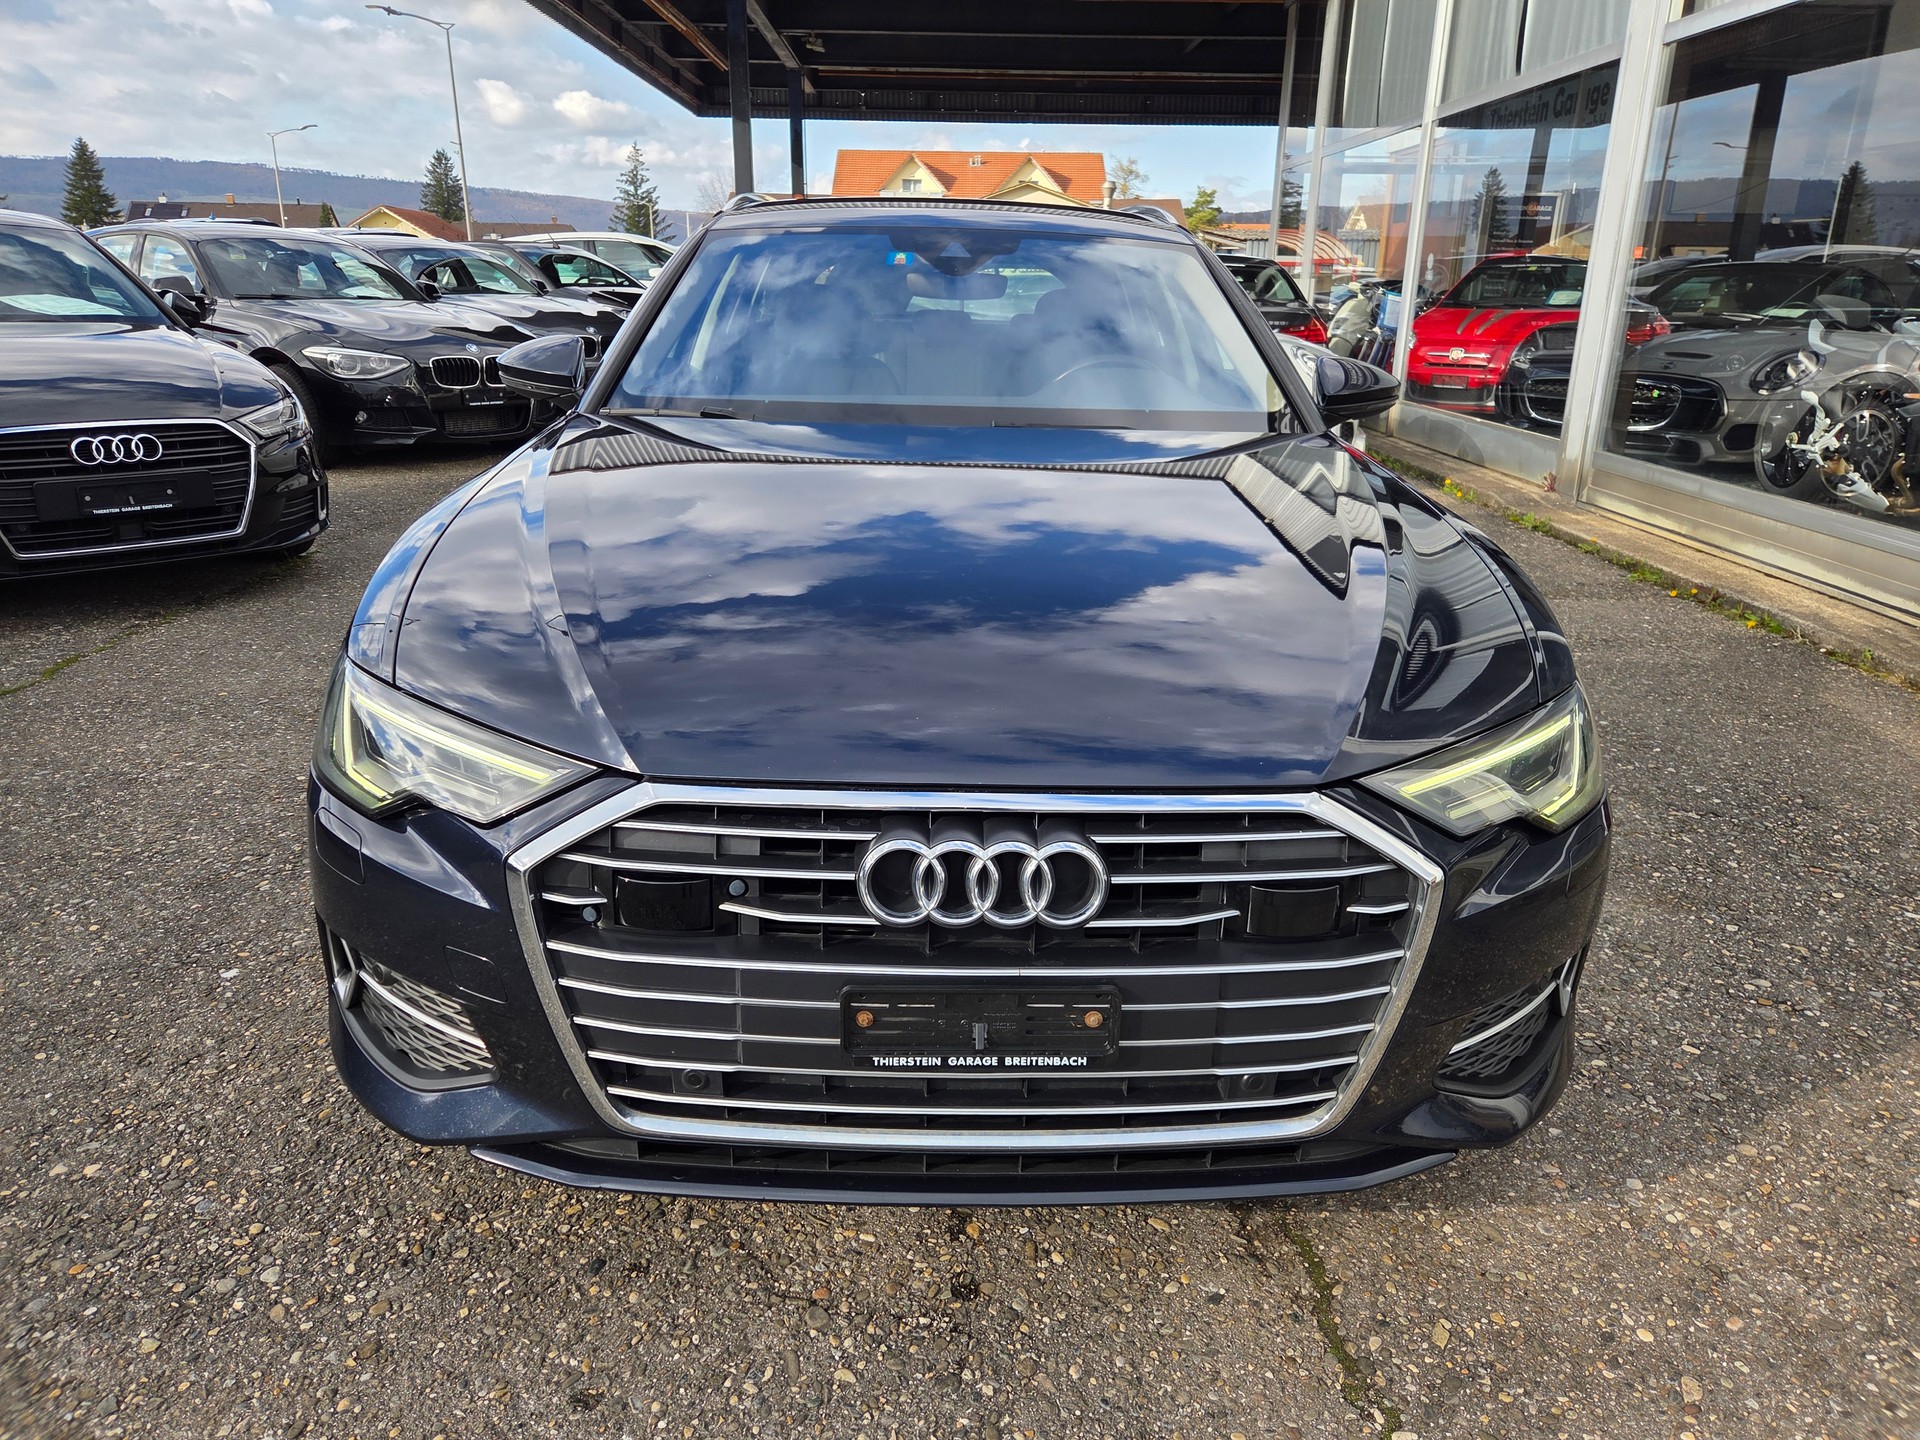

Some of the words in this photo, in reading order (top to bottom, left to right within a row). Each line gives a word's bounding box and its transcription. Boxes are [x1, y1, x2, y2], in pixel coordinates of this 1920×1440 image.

[872, 1056, 942, 1067] THIERSTEIN
[947, 1056, 999, 1067] GARAGE
[1004, 1056, 1088, 1067] BREITENBACH
